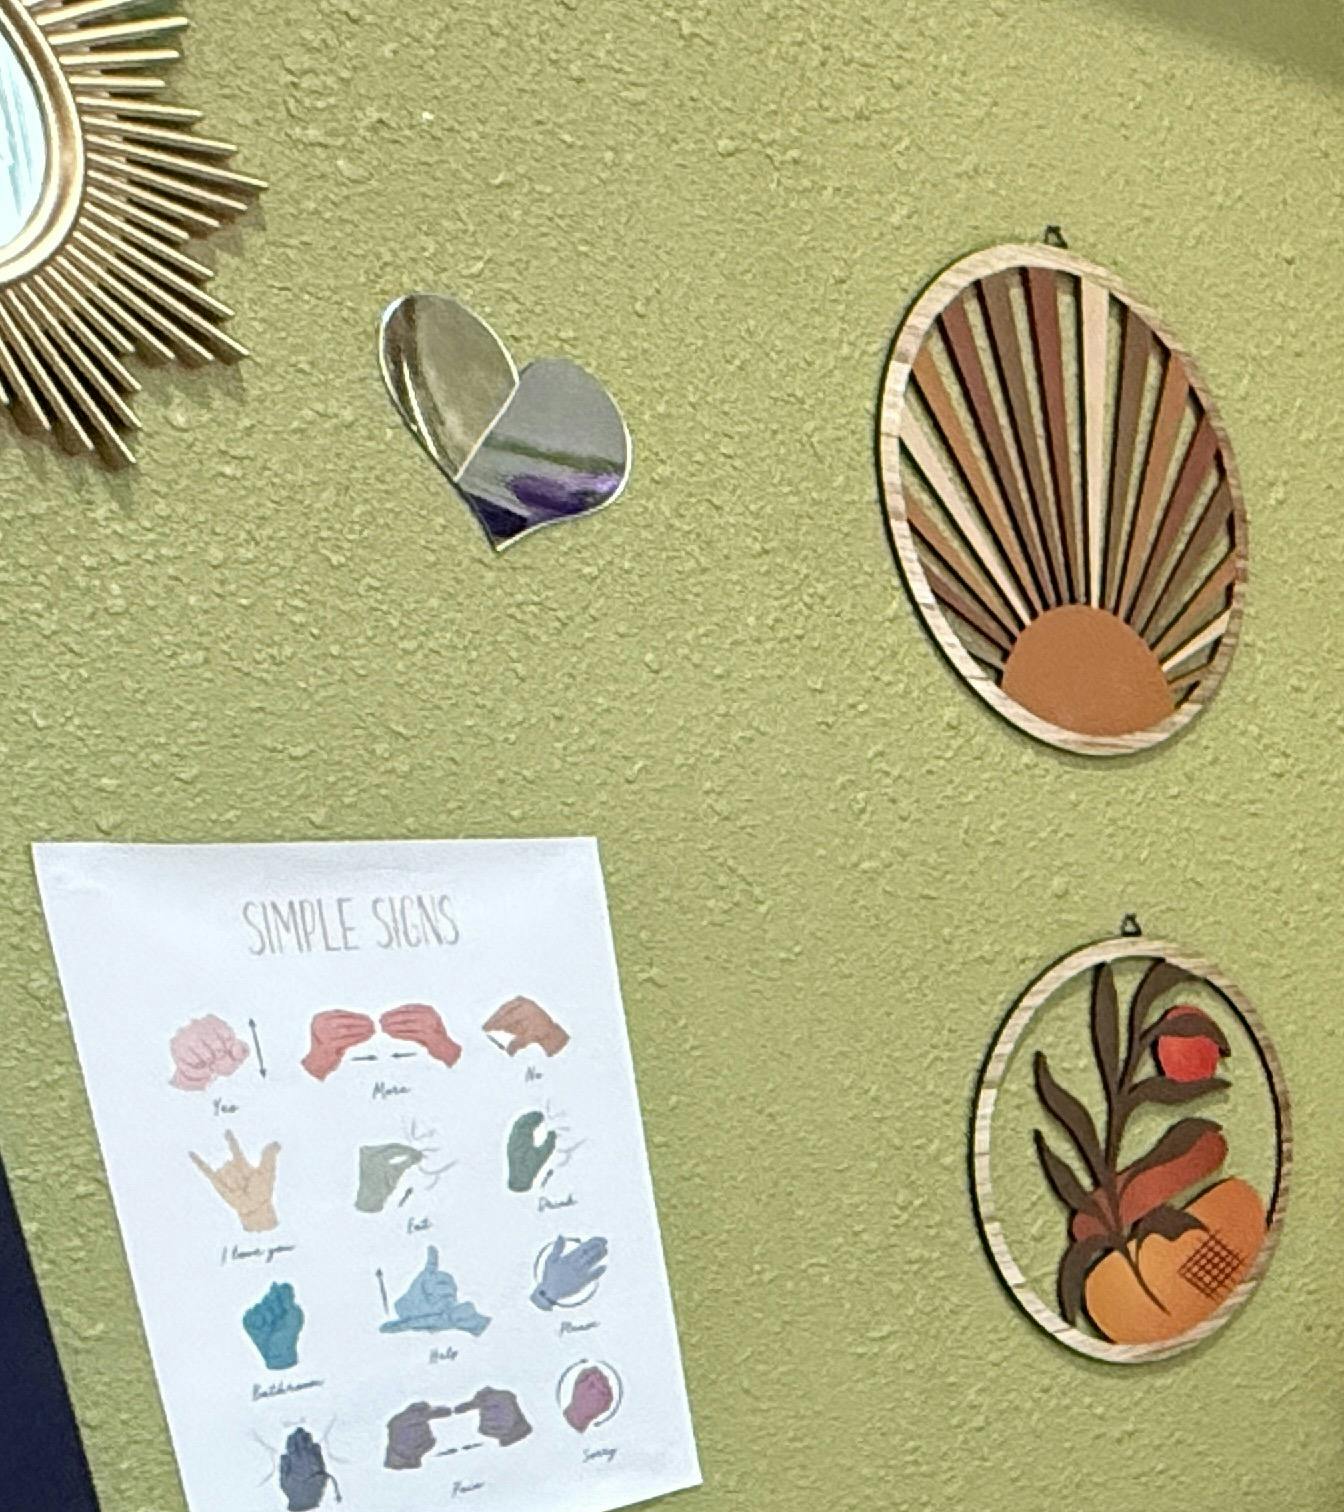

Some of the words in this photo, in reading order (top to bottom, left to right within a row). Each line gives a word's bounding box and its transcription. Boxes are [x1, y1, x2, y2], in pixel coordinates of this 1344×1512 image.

[242, 896, 359, 955] SIMPLE
[371, 894, 460, 949] SIGNS
[525, 1065, 542, 1083] No
[373, 1081, 410, 1099] More
[407, 1216, 432, 1234] Eat
[429, 1346, 459, 1364] Help
[252, 1379, 325, 1401] Bathroom
